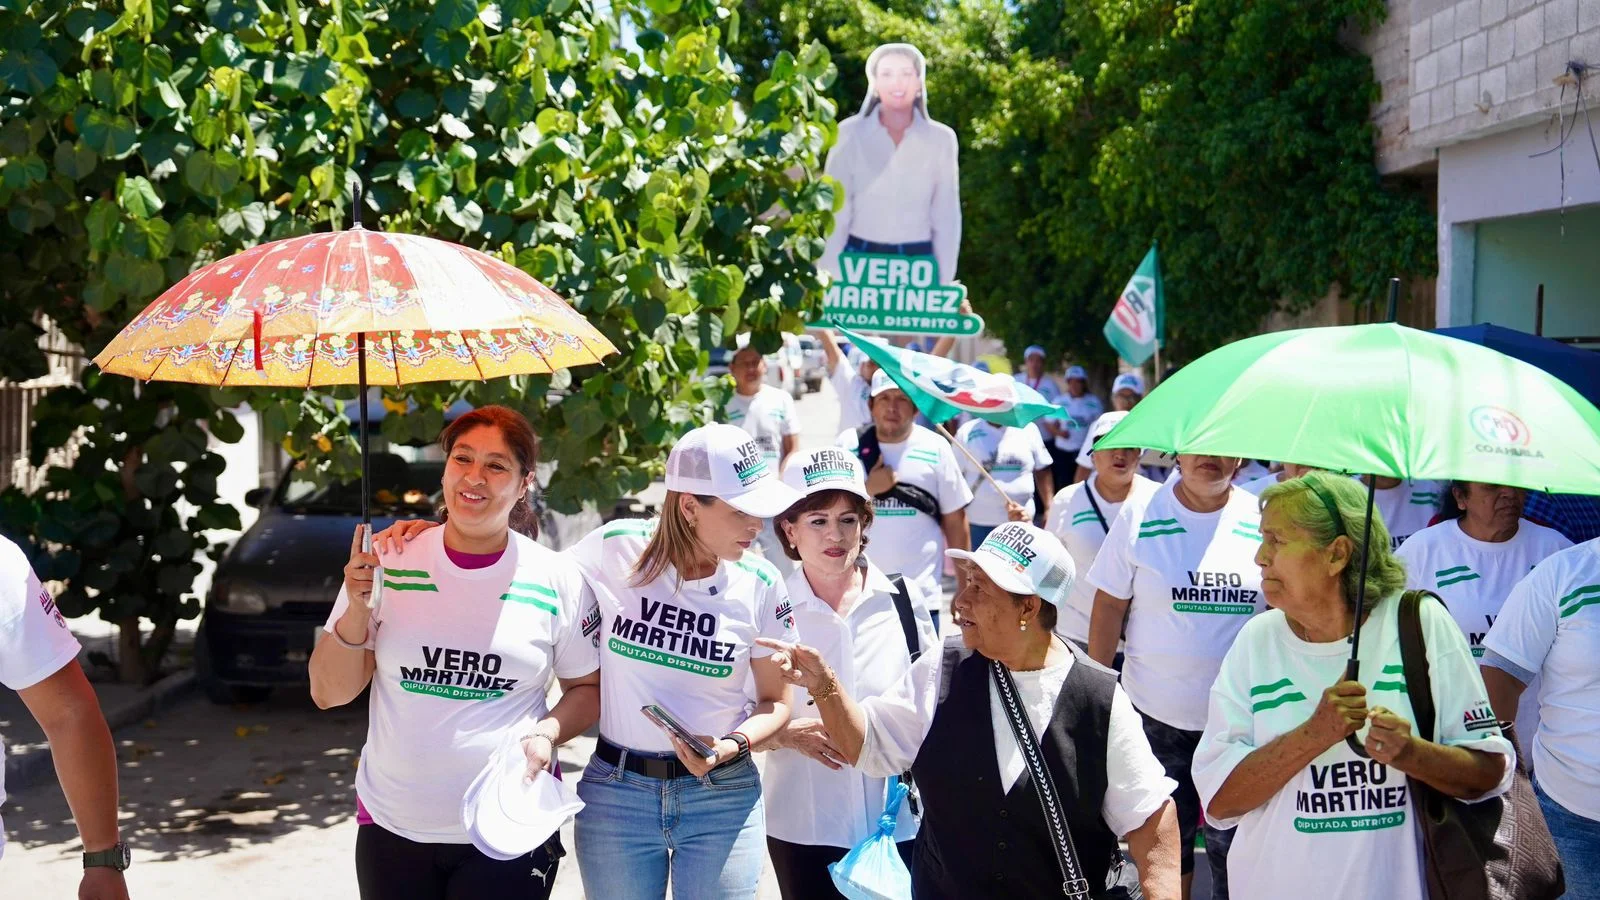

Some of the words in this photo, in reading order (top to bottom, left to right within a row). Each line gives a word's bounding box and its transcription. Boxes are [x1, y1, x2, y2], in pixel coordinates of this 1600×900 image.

[843, 257, 934, 288] VERO
[823, 283, 960, 314] MARTÍNEZ
[884, 315, 958, 329] DISTRITO
[963, 319, 973, 330] 9
[810, 450, 844, 463] VERO
[1002, 524, 1035, 546] VERO
[1187, 571, 1242, 588] VERO
[1171, 587, 1258, 604] MARTÍNEZ
[641, 597, 716, 637] VERO
[611, 615, 737, 663] MARTÍNEZ
[422, 646, 502, 676] VERO
[611, 641, 664, 662] DIPUTADA
[667, 657, 720, 675] DISTRITO
[403, 682, 450, 695] DIPUTADA
[1310, 759, 1387, 790] VERO
[1296, 785, 1407, 814] MARTÍNEZ
[1297, 820, 1348, 830] DIPUTADA
[1351, 816, 1394, 828] DISTRITO
